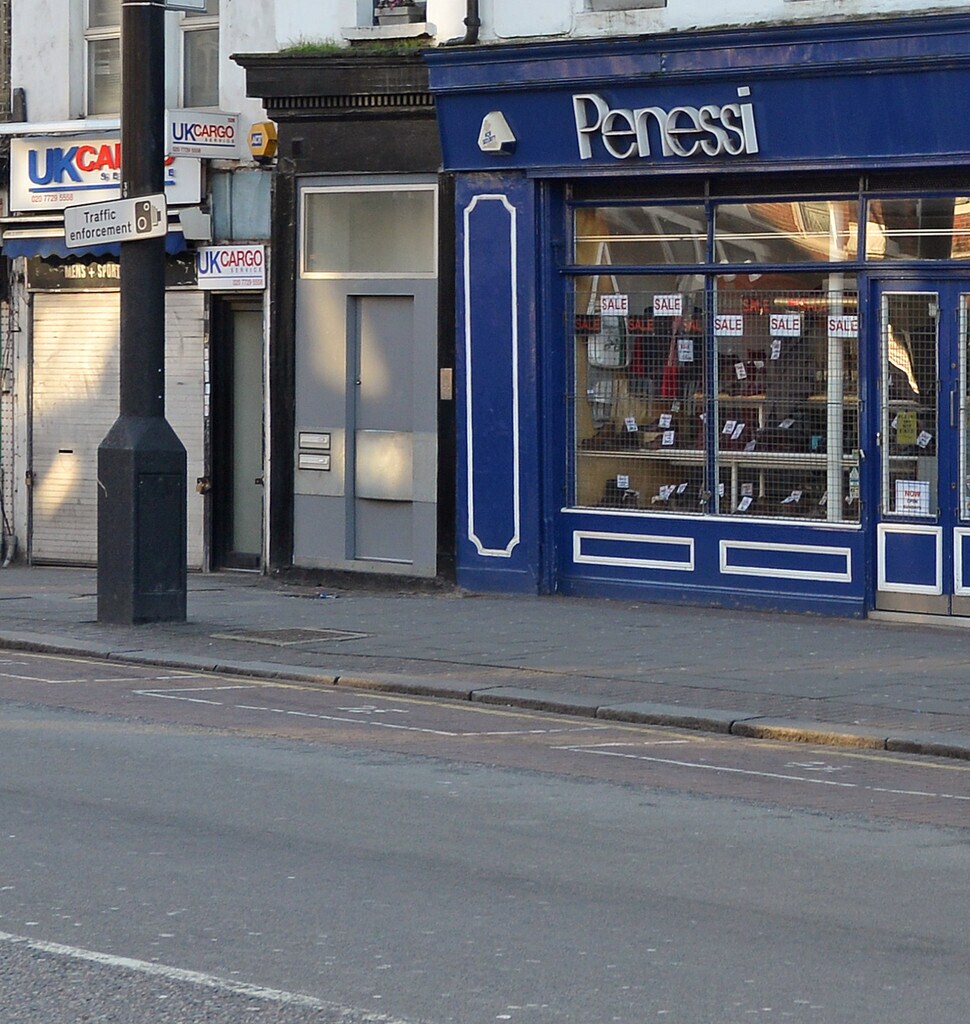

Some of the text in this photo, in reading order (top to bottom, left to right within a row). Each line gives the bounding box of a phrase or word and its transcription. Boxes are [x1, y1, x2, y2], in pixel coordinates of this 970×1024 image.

[572, 86, 759, 160] Penessi
[84, 208, 116, 224] Traffic
[69, 221, 132, 241] enforcement
[65, 264, 87, 279] MENS
[601, 298, 627, 310] SALE
[654, 298, 681, 310] SALE
[628, 318, 654, 330] SALE
[714, 319, 742, 330] SALE
[771, 318, 800, 331] SALE
[828, 319, 858, 332] SALE
